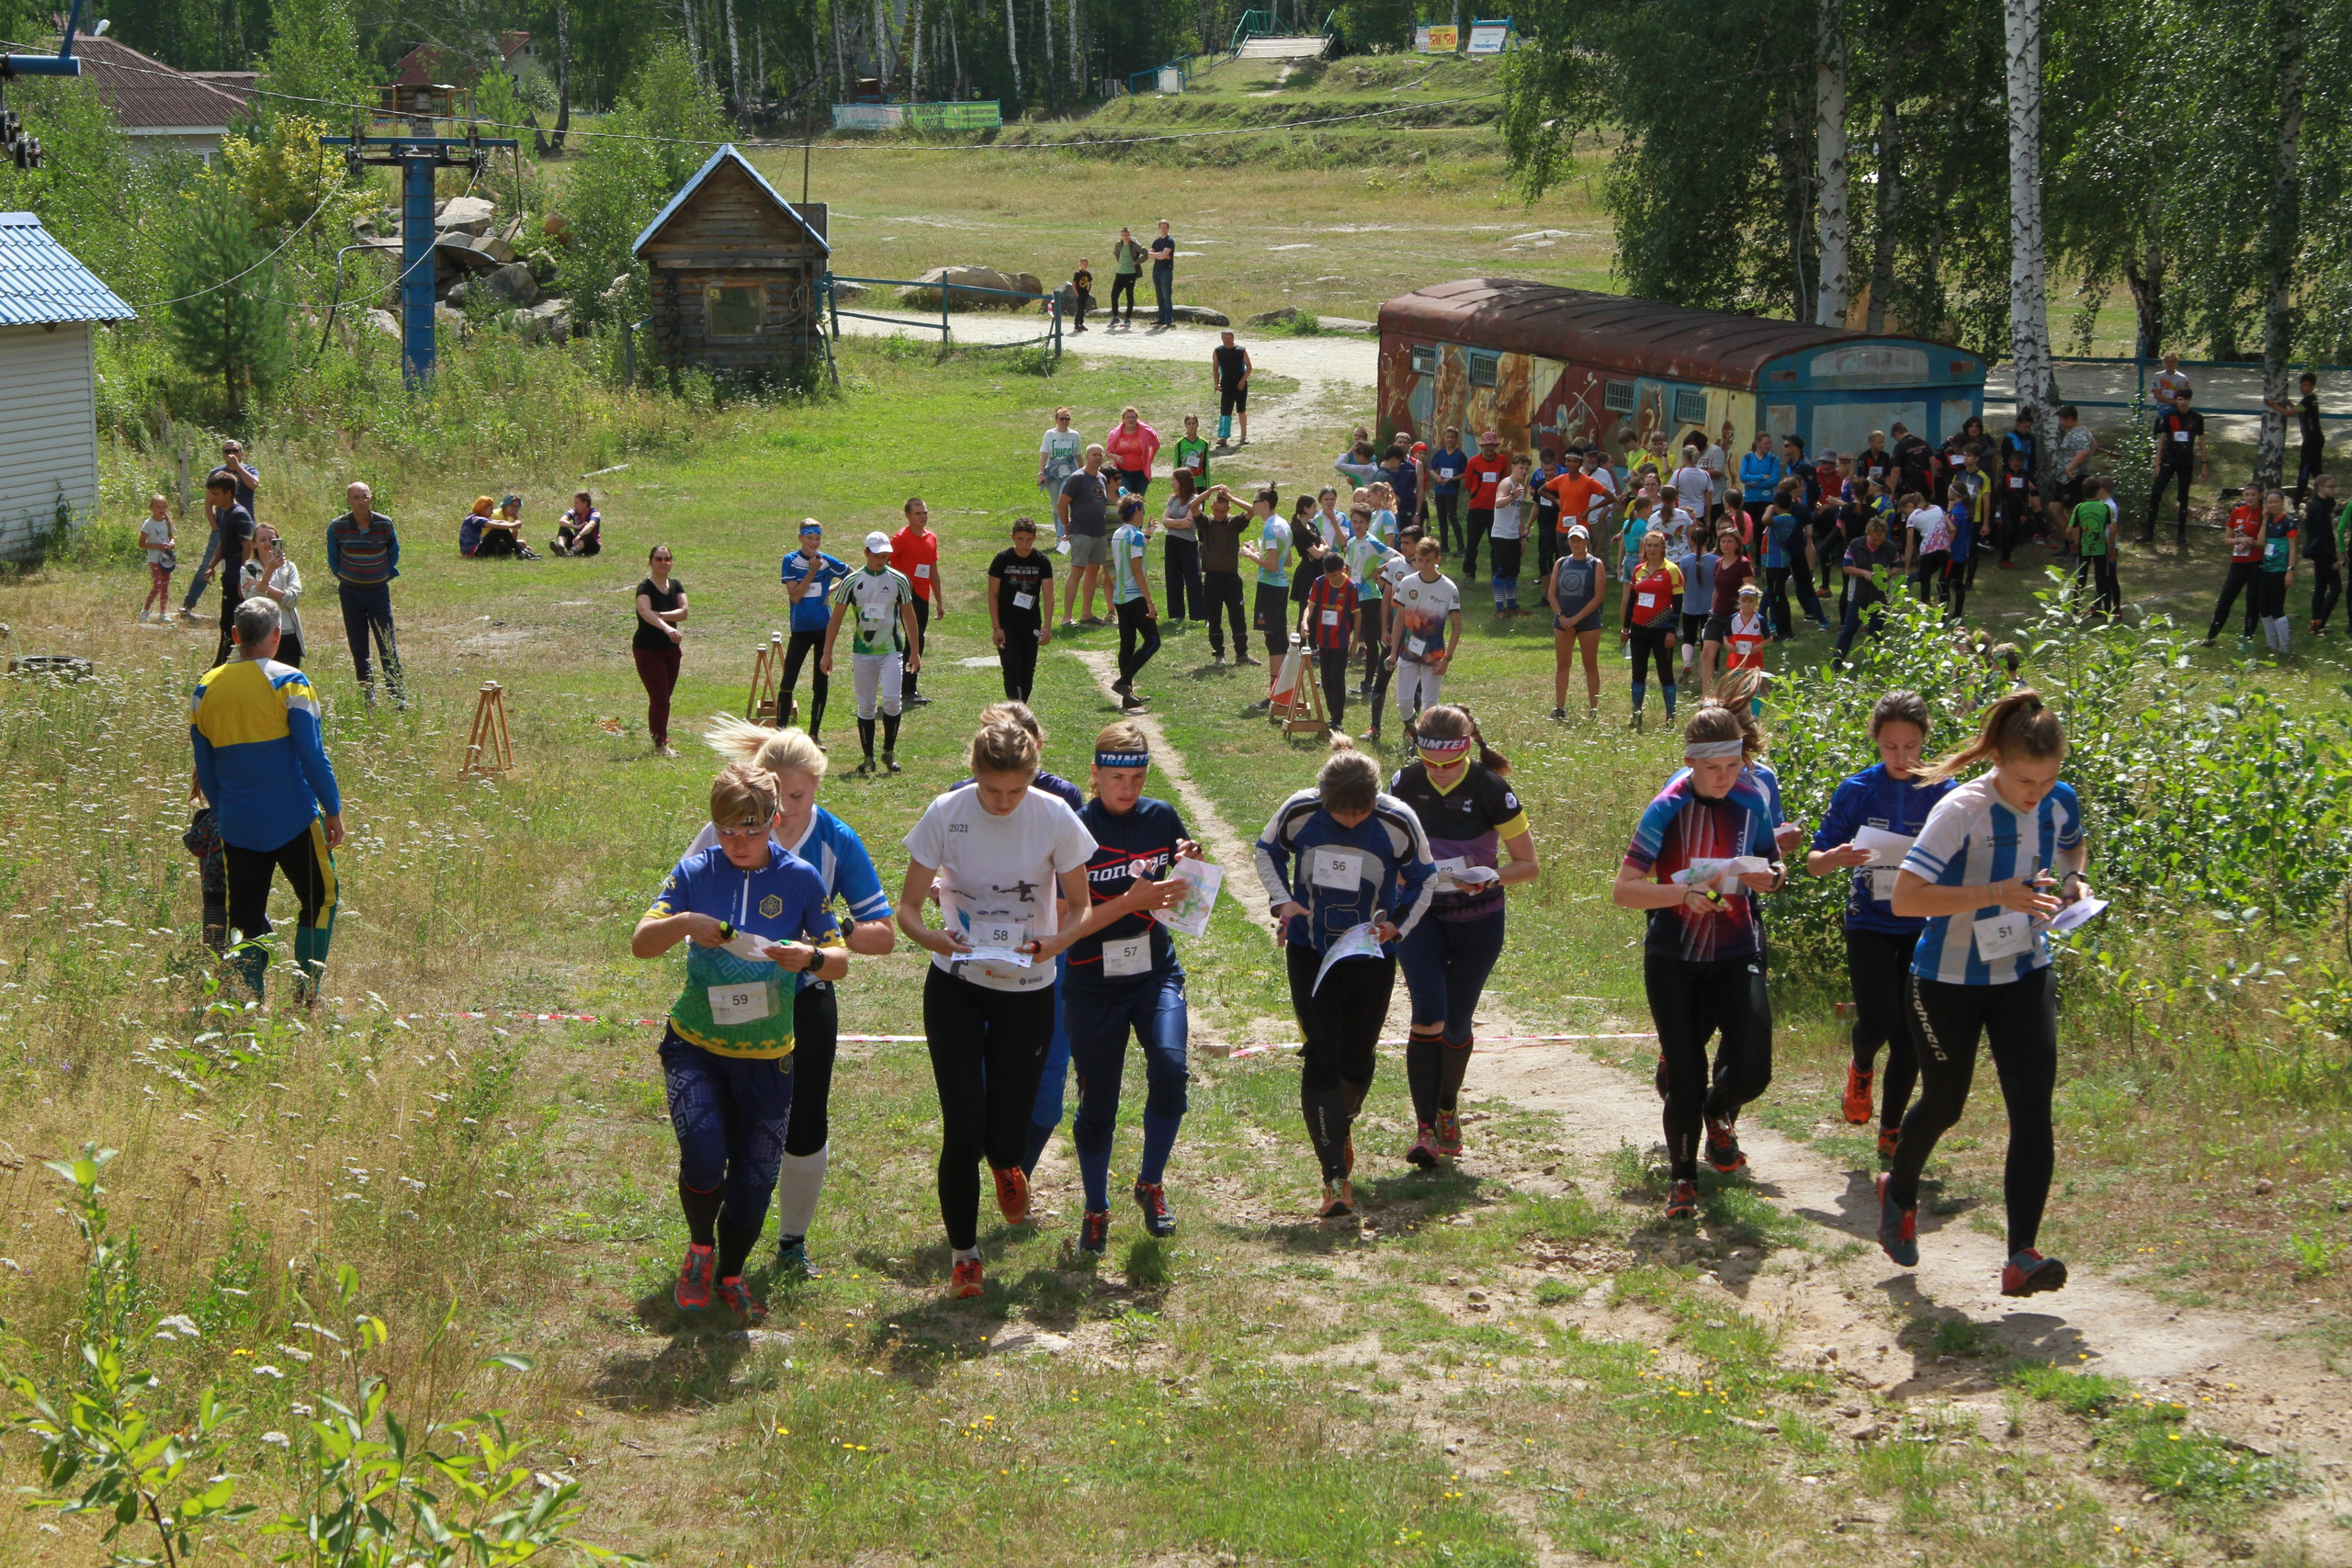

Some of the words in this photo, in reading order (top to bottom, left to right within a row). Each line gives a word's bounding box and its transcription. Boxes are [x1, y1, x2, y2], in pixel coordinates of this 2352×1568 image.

[915, 104, 948, 117] МИНСПОРТ
[949, 824, 968, 833] 2021
[1332, 860, 1346, 871] 56
[993, 930, 1008, 941] 58
[1998, 925, 2013, 938] 51
[1124, 946, 1137, 957] 57
[732, 994, 748, 1006] 59
